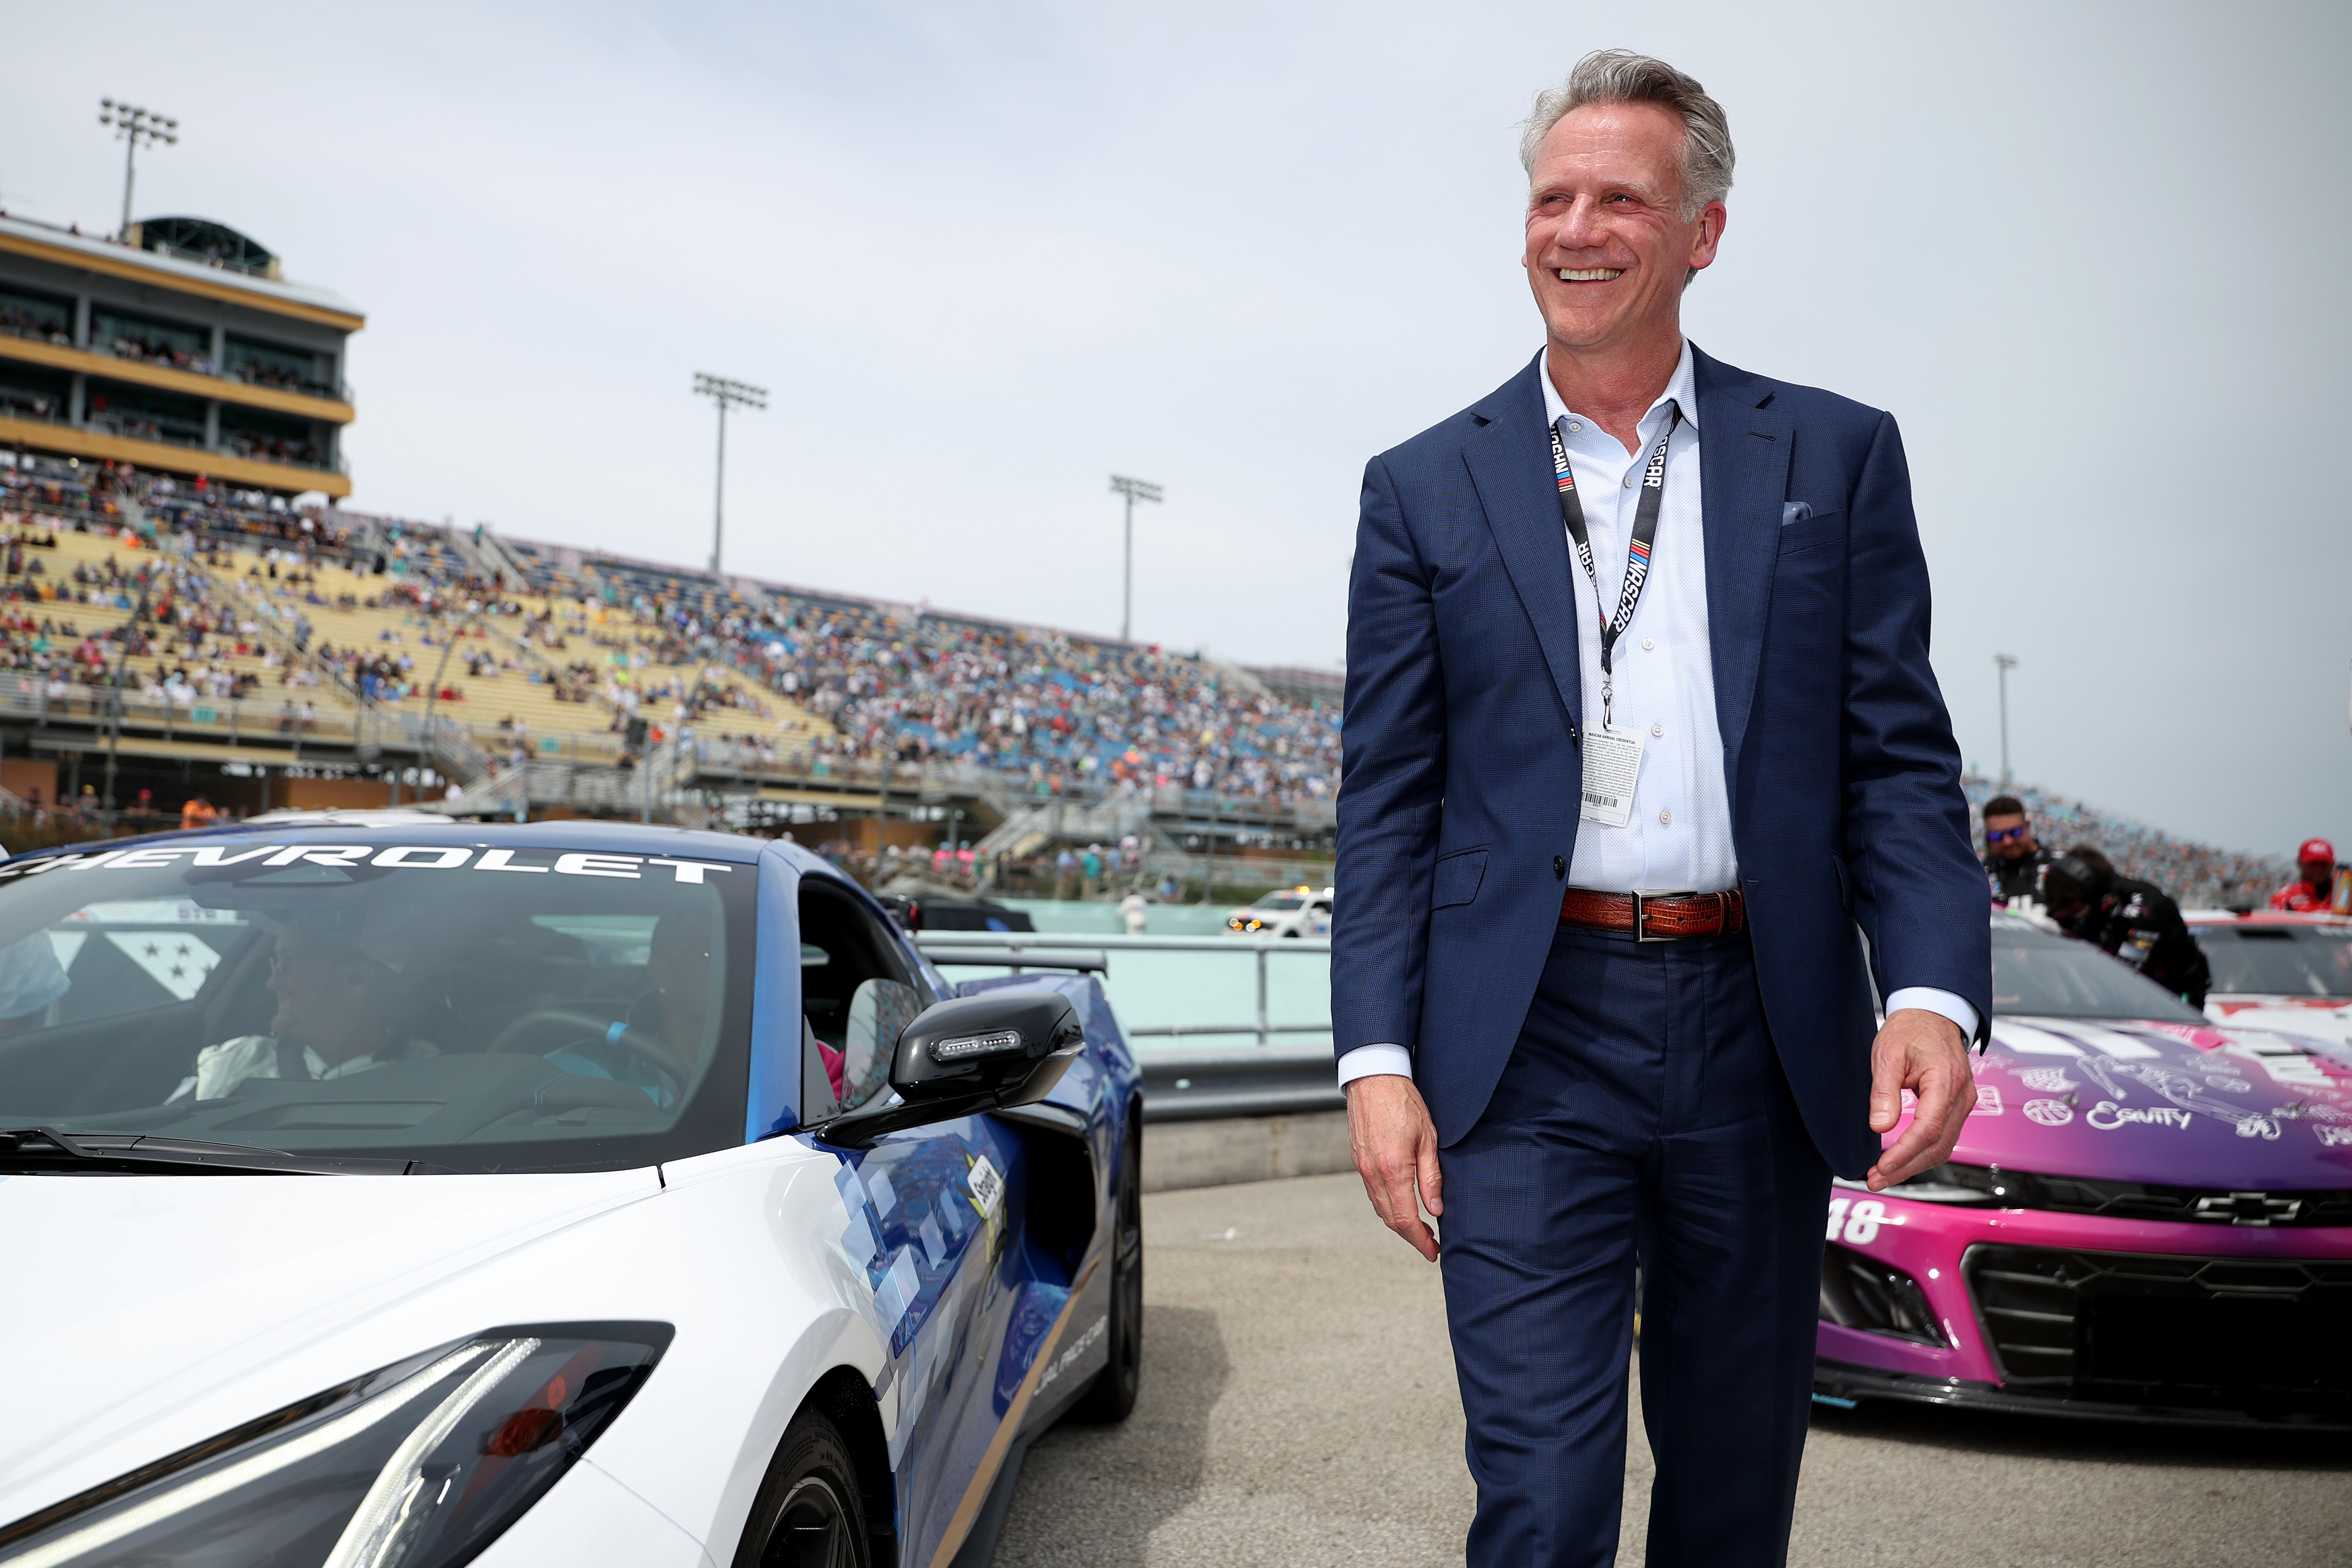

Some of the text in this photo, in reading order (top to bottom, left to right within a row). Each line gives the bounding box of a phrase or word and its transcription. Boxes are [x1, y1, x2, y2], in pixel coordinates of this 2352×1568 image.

[1613, 560, 1647, 633] NASCAR
[1616, 737, 1636, 745] CREDENTIAL
[0, 845, 732, 884] CHEVROLET
[1826, 1198, 1886, 1245] 48
